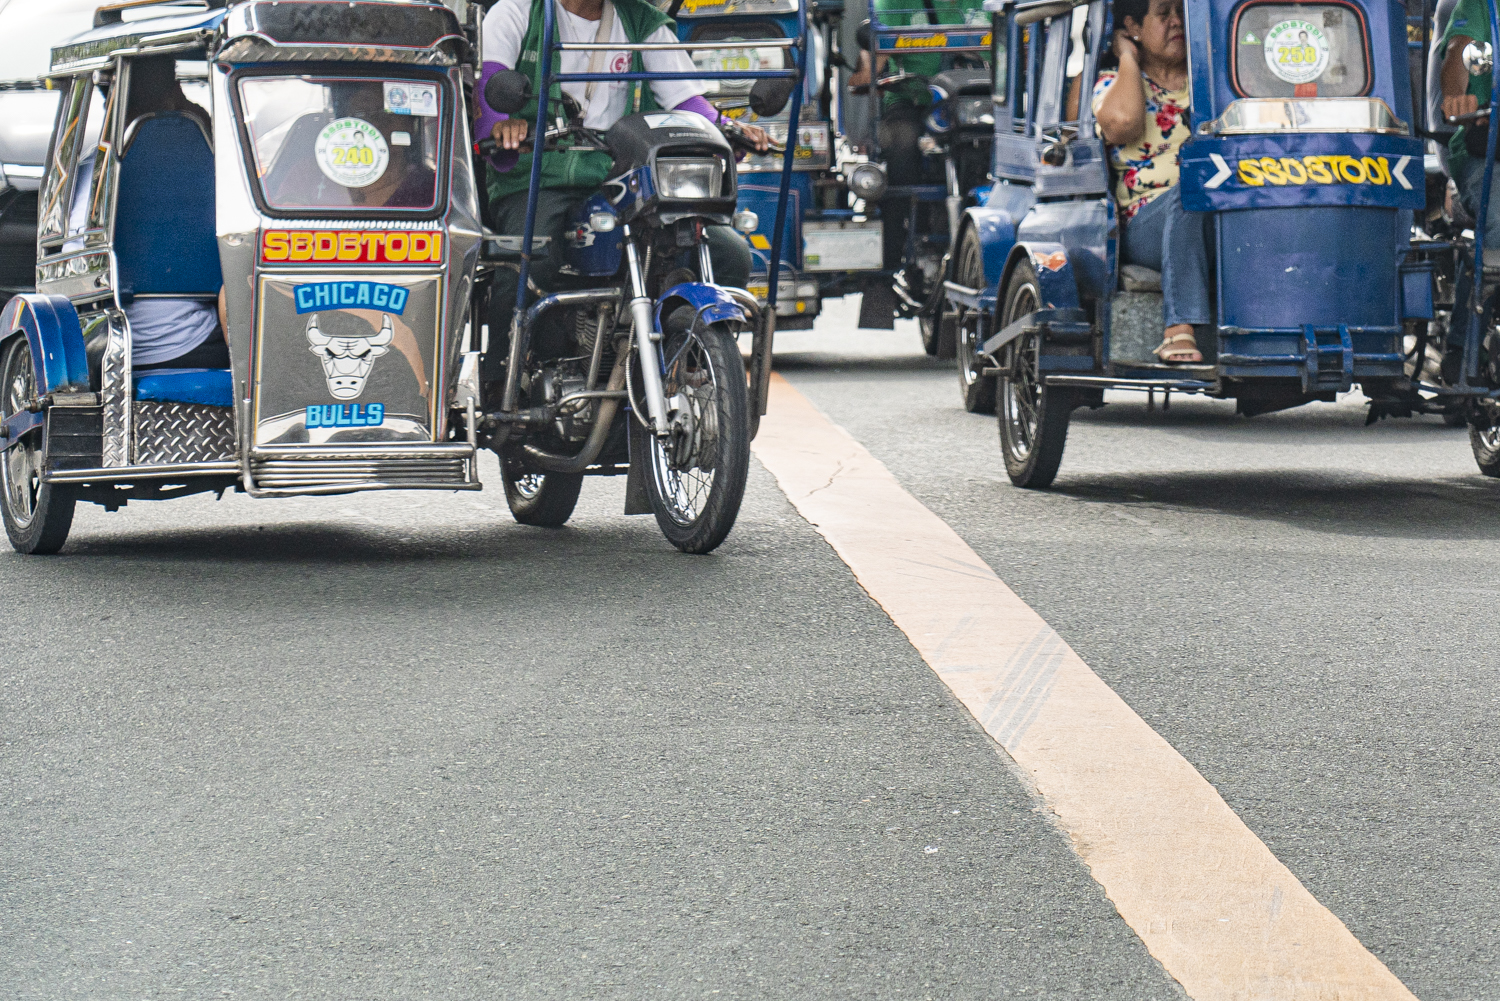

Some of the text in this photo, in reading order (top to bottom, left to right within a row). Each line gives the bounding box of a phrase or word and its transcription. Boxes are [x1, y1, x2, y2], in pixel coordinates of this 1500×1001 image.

[1278, 46, 1317, 64] 258
[331, 147, 374, 166] 240
[1237, 154, 1393, 187] SBDBTODI
[264, 231, 442, 261] SBDBTODI
[296, 282, 408, 311] CHICAGO
[305, 403, 385, 427] BULLS
